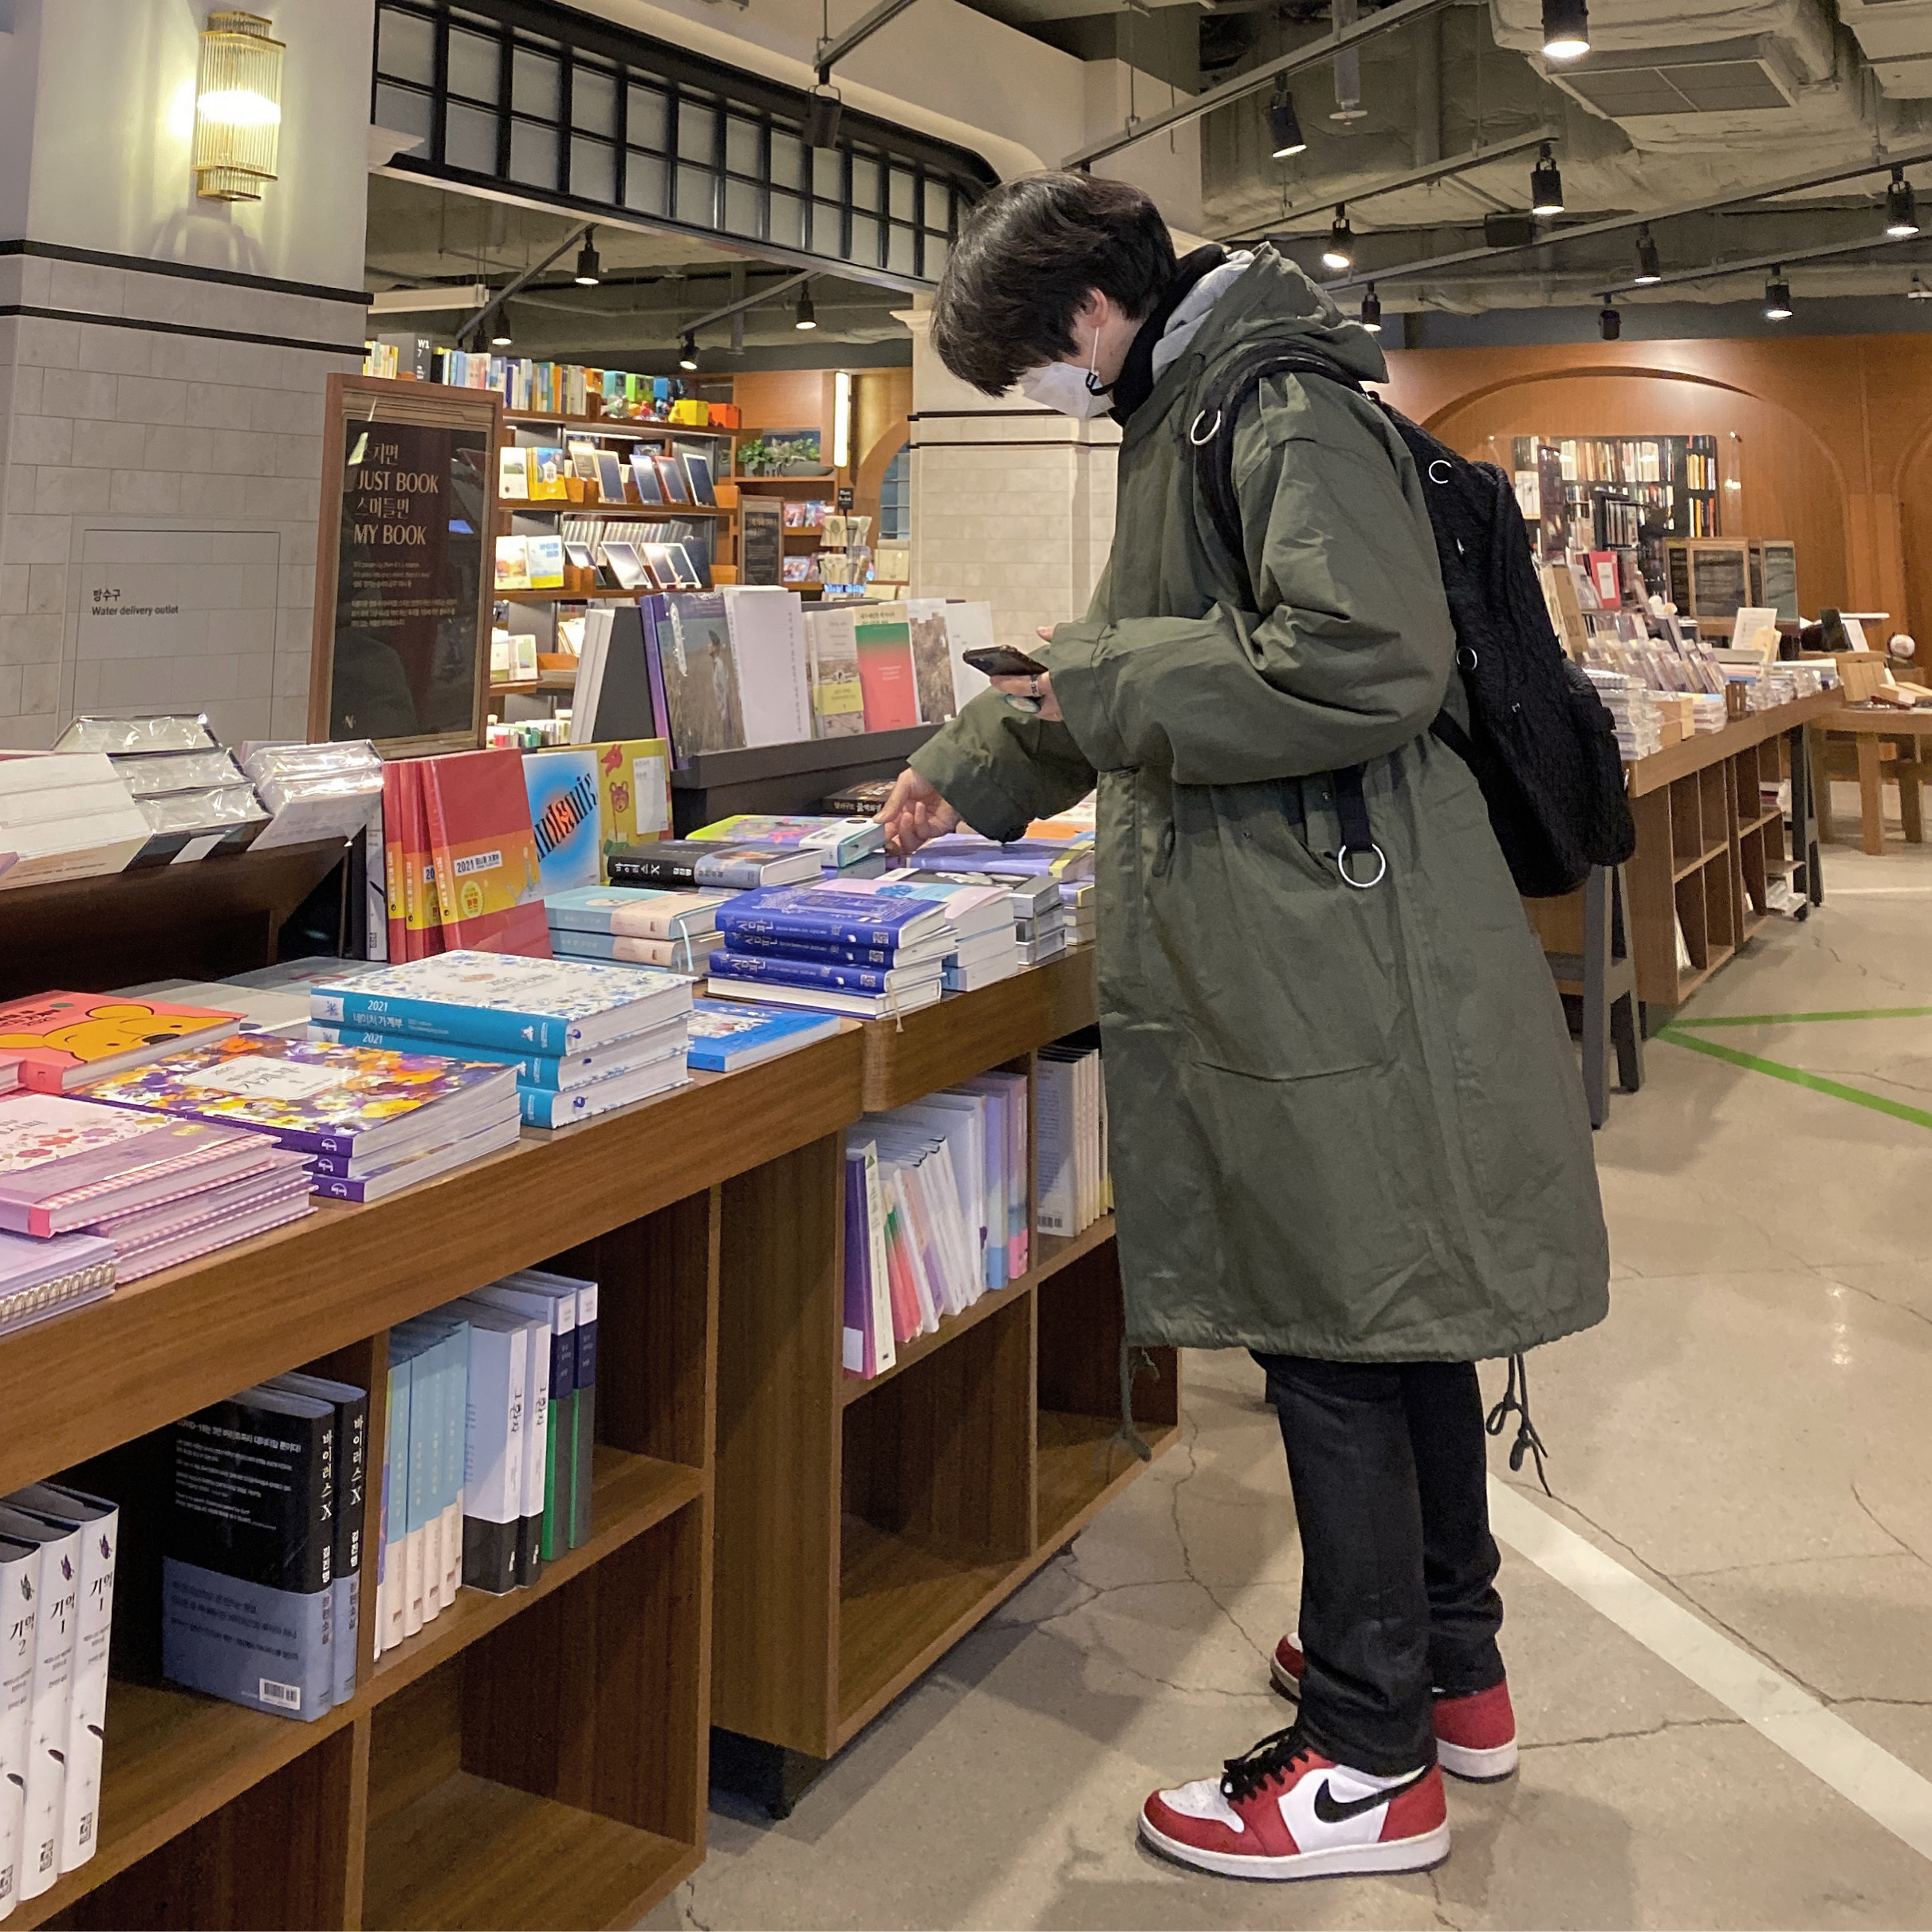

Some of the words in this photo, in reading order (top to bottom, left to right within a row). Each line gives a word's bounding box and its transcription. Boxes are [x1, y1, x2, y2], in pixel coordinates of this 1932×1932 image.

[358, 470, 391, 490] JUST
[395, 472, 439, 494] BOOK
[353, 523, 378, 545] MY
[383, 524, 427, 545] BOOK
[93, 588, 121, 602] 방수구
[92, 606, 117, 616] Water
[120, 606, 152, 617] delivery
[155, 604, 179, 615] outlet
[425, 867, 435, 879] 20
[457, 860, 474, 873] 2021
[615, 862, 649, 875] 바이러스
[736, 917, 774, 934] 심판
[730, 958, 766, 974] 심판
[368, 999, 388, 1013] 2021
[379, 1014, 403, 1030] 가계부
[363, 1033, 384, 1045] 2021
[351, 1415, 364, 1483] 바이러스
[321, 1429, 333, 1498] 바이러스
[351, 1485, 361, 1505] X
[321, 1501, 332, 1521] X
[89, 1571, 113, 1598] 기억
[50, 1592, 76, 1619] 기억
[99, 1596, 104, 1612] 1
[10, 1612, 35, 1641] 기억
[61, 1619, 65, 1635] 1
[18, 1639, 26, 1657] 2
